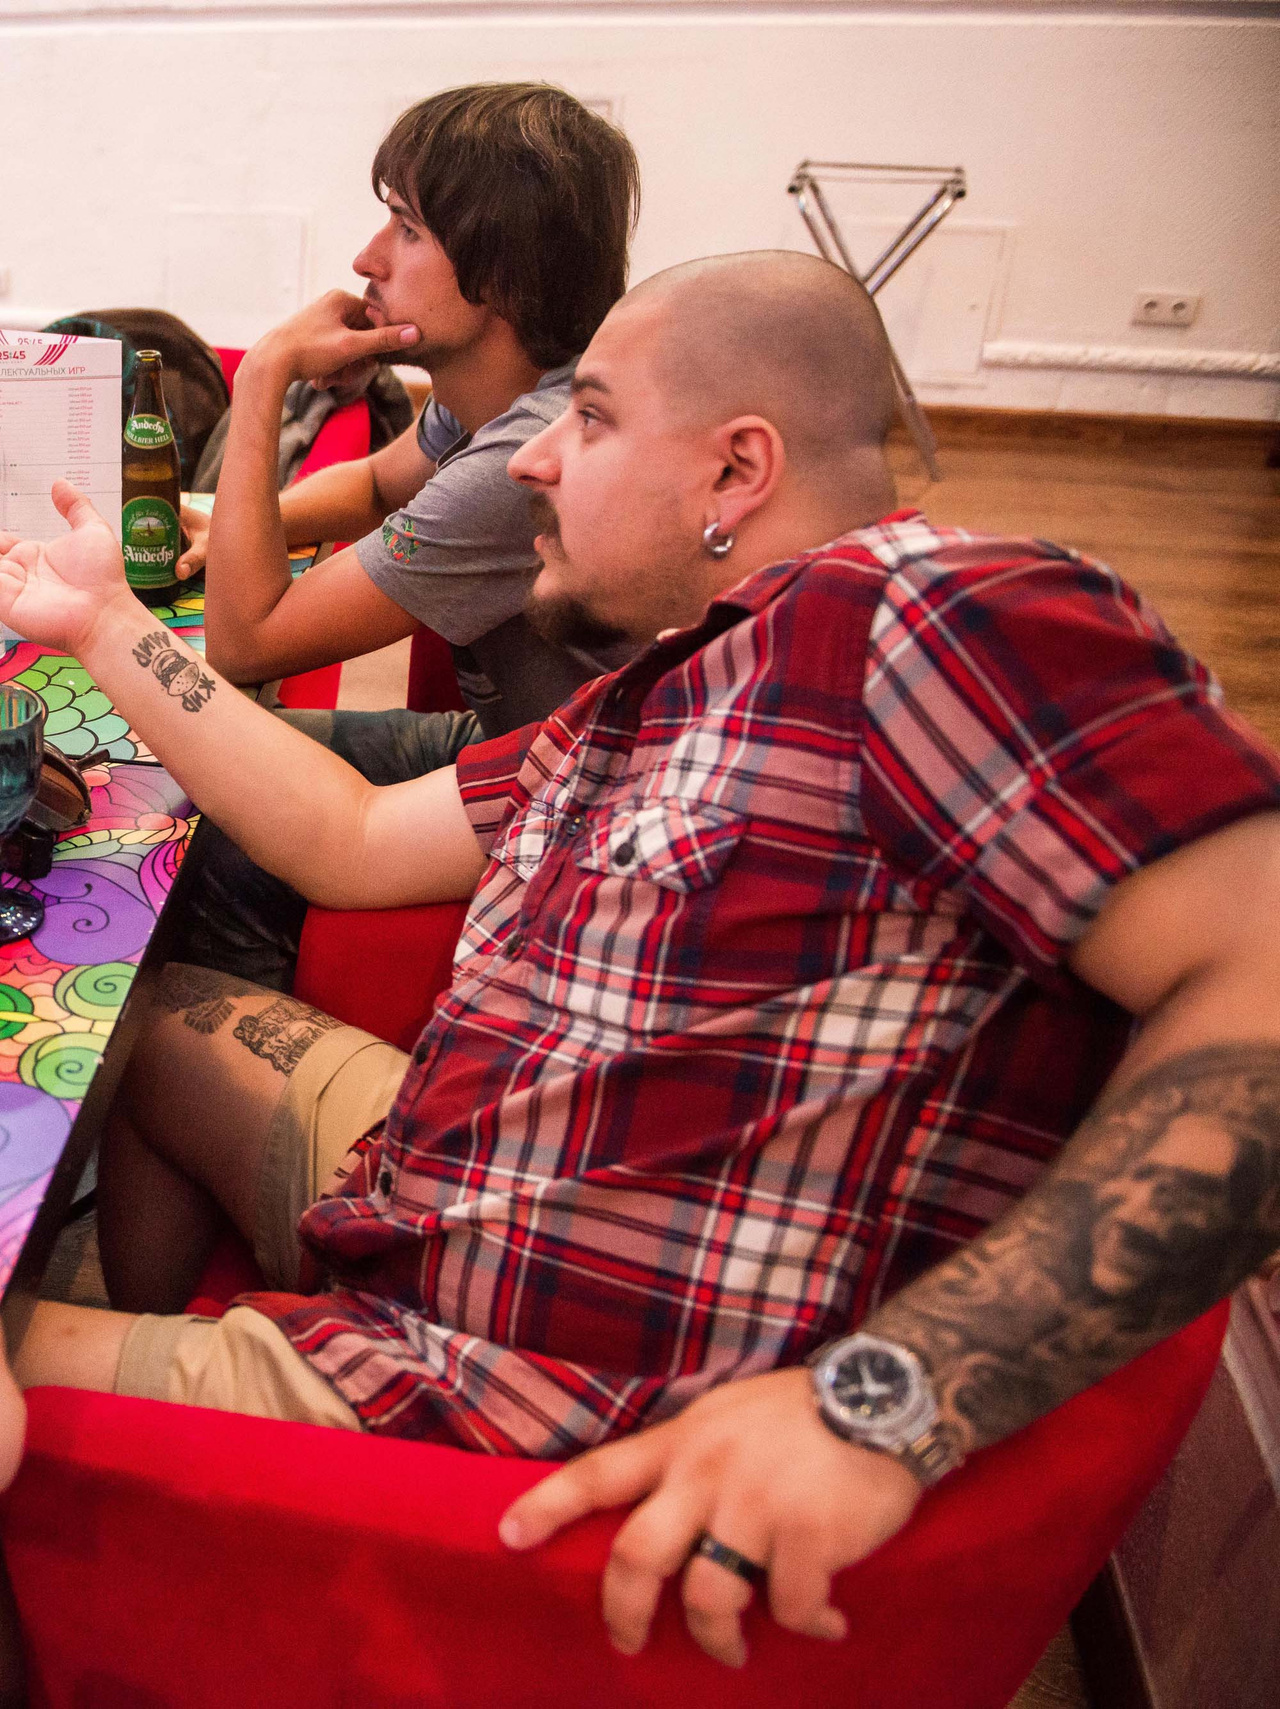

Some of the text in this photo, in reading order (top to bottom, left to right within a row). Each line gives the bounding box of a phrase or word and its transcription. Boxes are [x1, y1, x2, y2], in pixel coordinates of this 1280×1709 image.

[68, 366, 86, 375] ИГР
[131, 418, 165, 434] Andechs
[124, 545, 174, 567] Andechs
[181, 672, 217, 713] ЖИР
